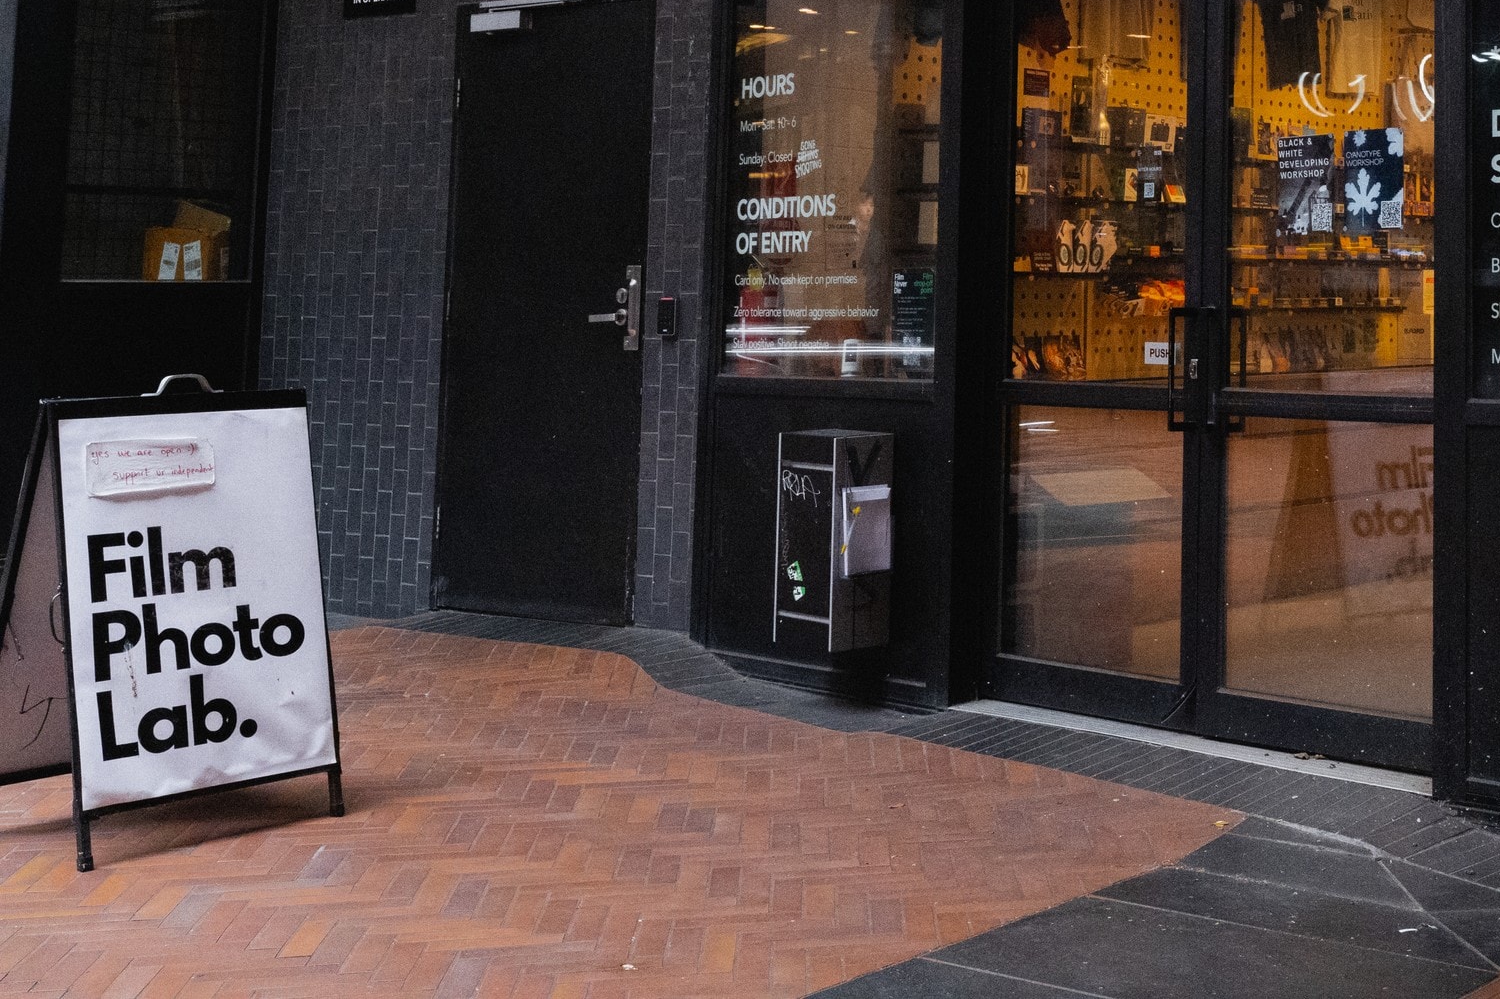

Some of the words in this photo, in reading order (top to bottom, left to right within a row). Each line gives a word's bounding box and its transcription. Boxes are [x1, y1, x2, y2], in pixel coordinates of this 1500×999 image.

[742, 73, 795, 100] HOURS
[740, 120, 756, 132] Mon
[792, 116, 796, 128] 6
[800, 140, 816, 151] GONE
[1278, 138, 1304, 148] BLACK
[1306, 137, 1312, 146] &
[739, 152, 766, 168] Sunday:
[768, 150, 793, 163] Closed
[1278, 149, 1303, 158] WHITE
[1345, 150, 1382, 159] CYANOTYPE
[1279, 158, 1330, 169] DEVELOPING
[1345, 158, 1384, 167] WORKSHOP
[1280, 169, 1325, 180] WORKSHOP
[737, 194, 836, 221] CONDITIONS
[736, 232, 758, 255] OF
[761, 230, 812, 254] ENTRY
[734, 274, 750, 286] Card
[768, 274, 780, 285] No
[780, 274, 796, 285] cash
[798, 274, 813, 288] kept
[814, 276, 824, 286] on
[826, 273, 858, 288] premises
[734, 306, 750, 318] Zero
[750, 306, 782, 318] tolerance
[783, 306, 808, 318] toward
[808, 306, 847, 320] aggressive
[848, 304, 880, 318] behavior
[1150, 348, 1170, 358] PUSH
[160, 448, 182, 457] open
[171, 463, 214, 478] independent
[87, 526, 237, 604] Film
[91, 602, 306, 682] Photo
[96, 674, 258, 762] Lab.
